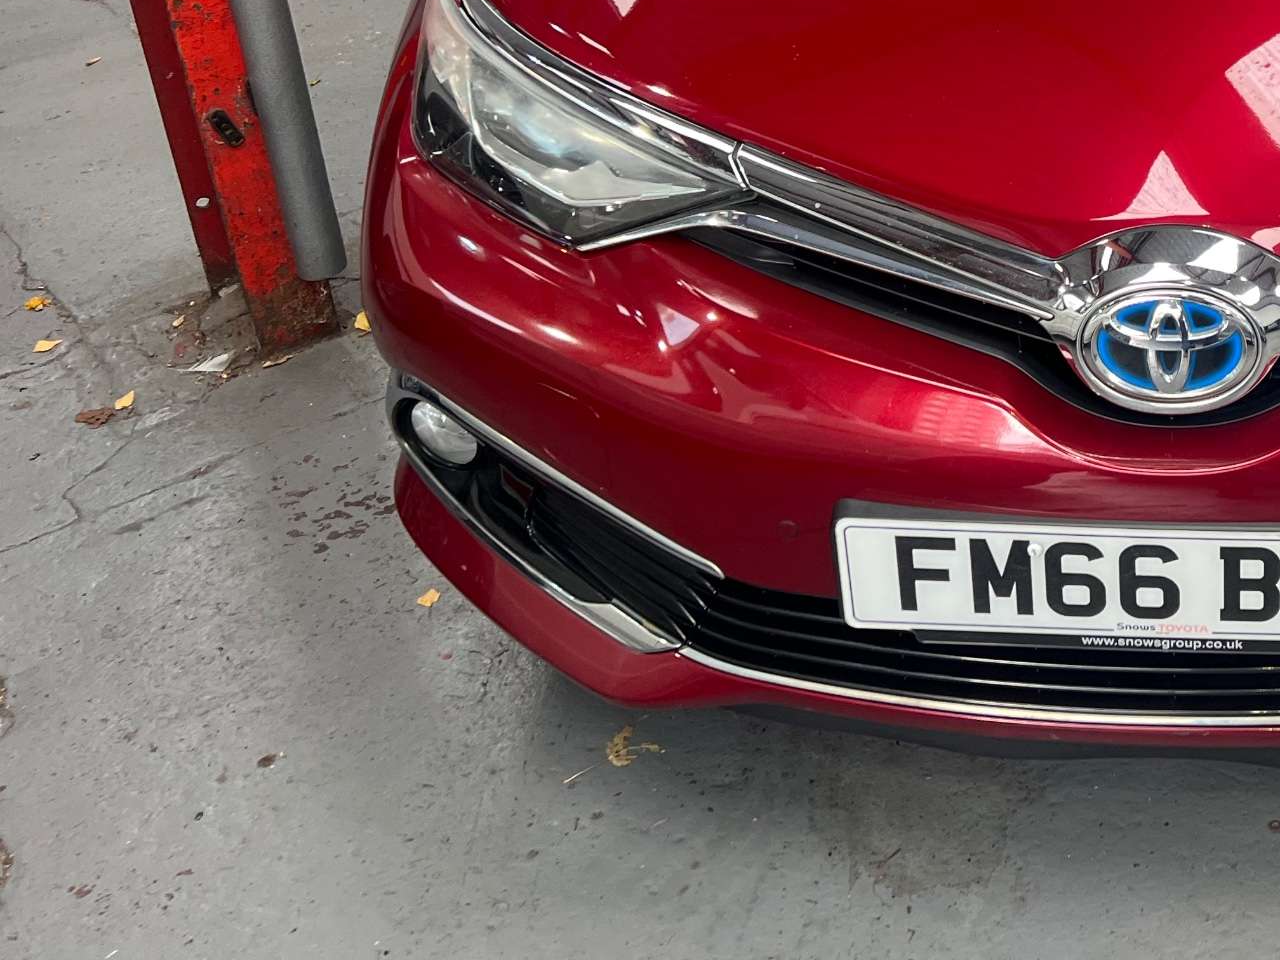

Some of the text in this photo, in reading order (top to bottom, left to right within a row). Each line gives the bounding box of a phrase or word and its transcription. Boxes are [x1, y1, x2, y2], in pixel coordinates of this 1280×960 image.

[894, 535, 1182, 620] FM66
[1116, 622, 1209, 633] Snows TOYOTA
[1081, 636, 1243, 651] www.snowsgroup.co.uk
